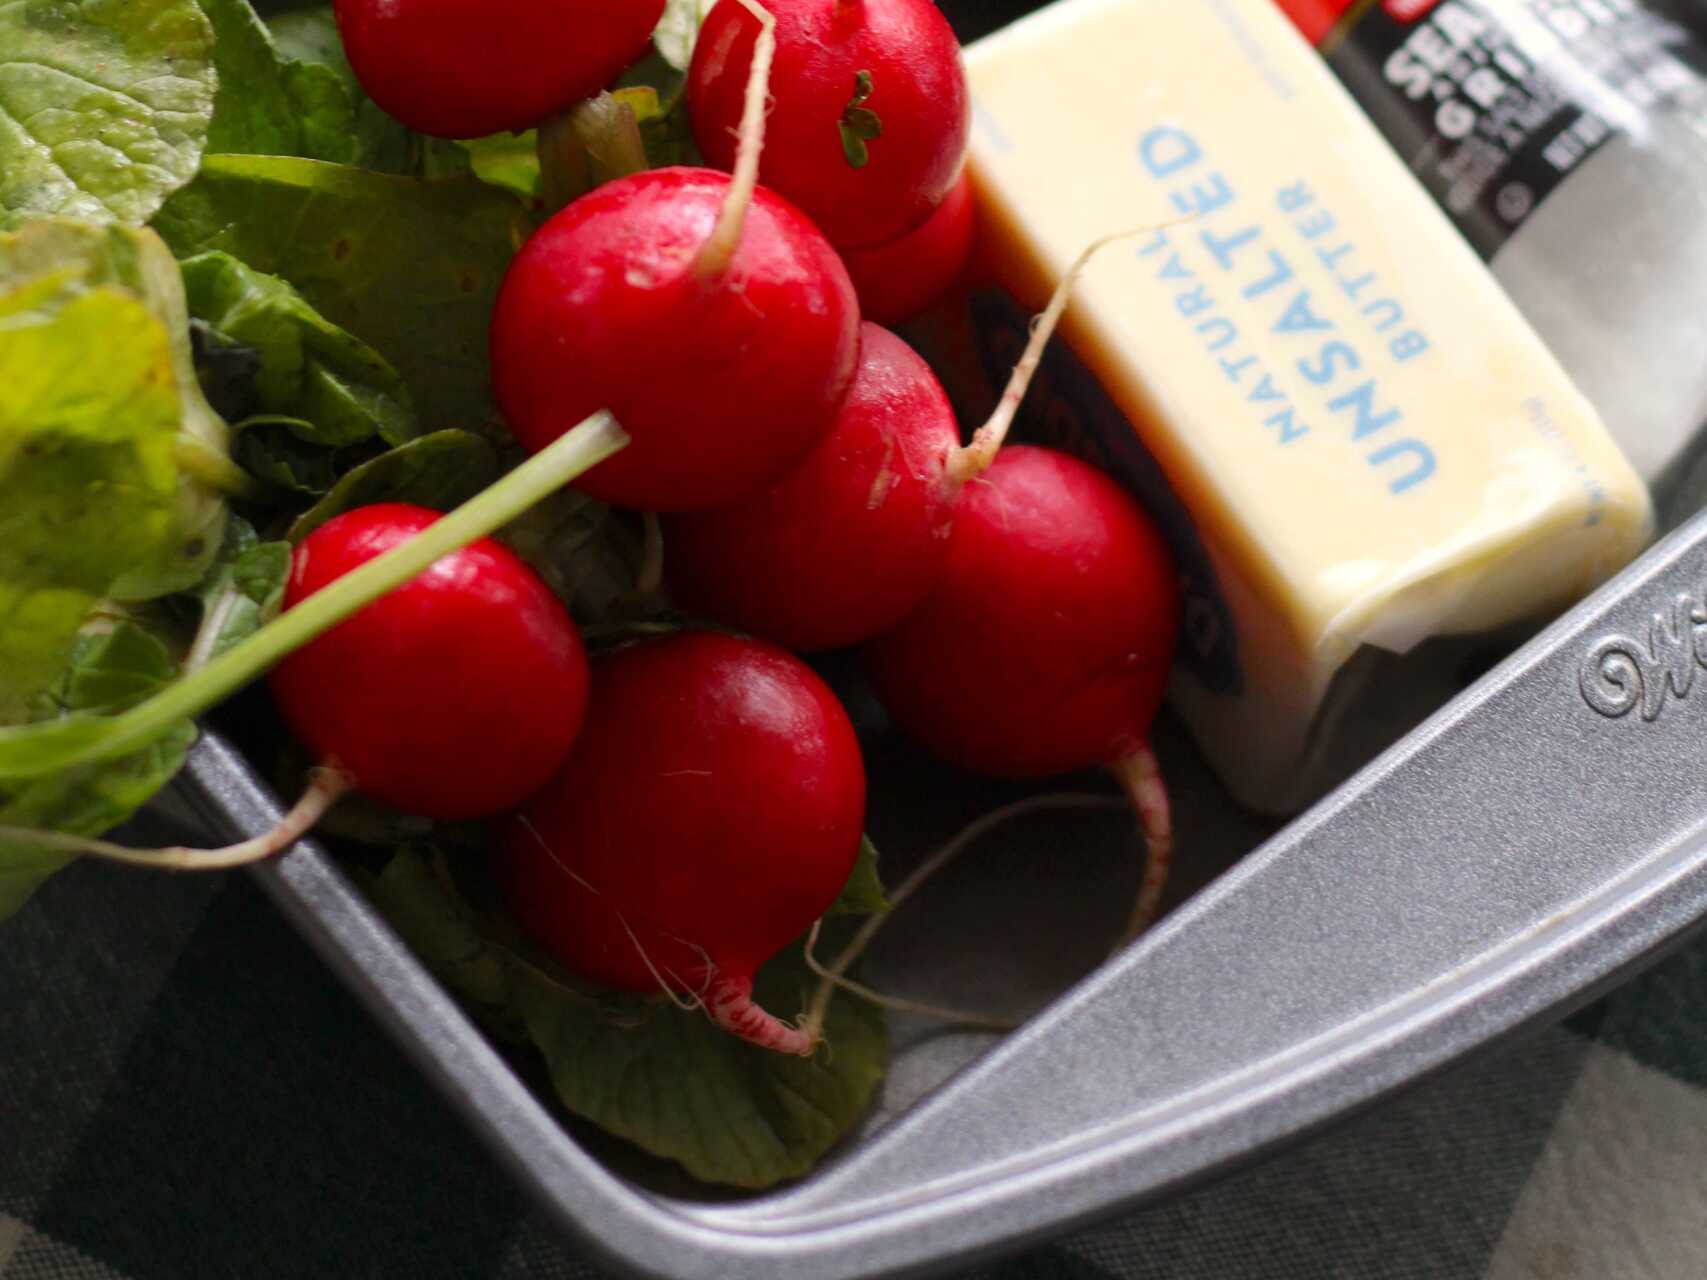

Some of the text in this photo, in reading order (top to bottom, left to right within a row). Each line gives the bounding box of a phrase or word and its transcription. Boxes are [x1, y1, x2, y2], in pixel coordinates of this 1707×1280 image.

[1383, 1, 1490, 100] SEA
[1137, 228, 1310, 445] NATURAL
[1138, 126, 1437, 495] UNSALTED
[1275, 179, 1430, 363] BUTTER
[1578, 592, 1707, 723] Wi
